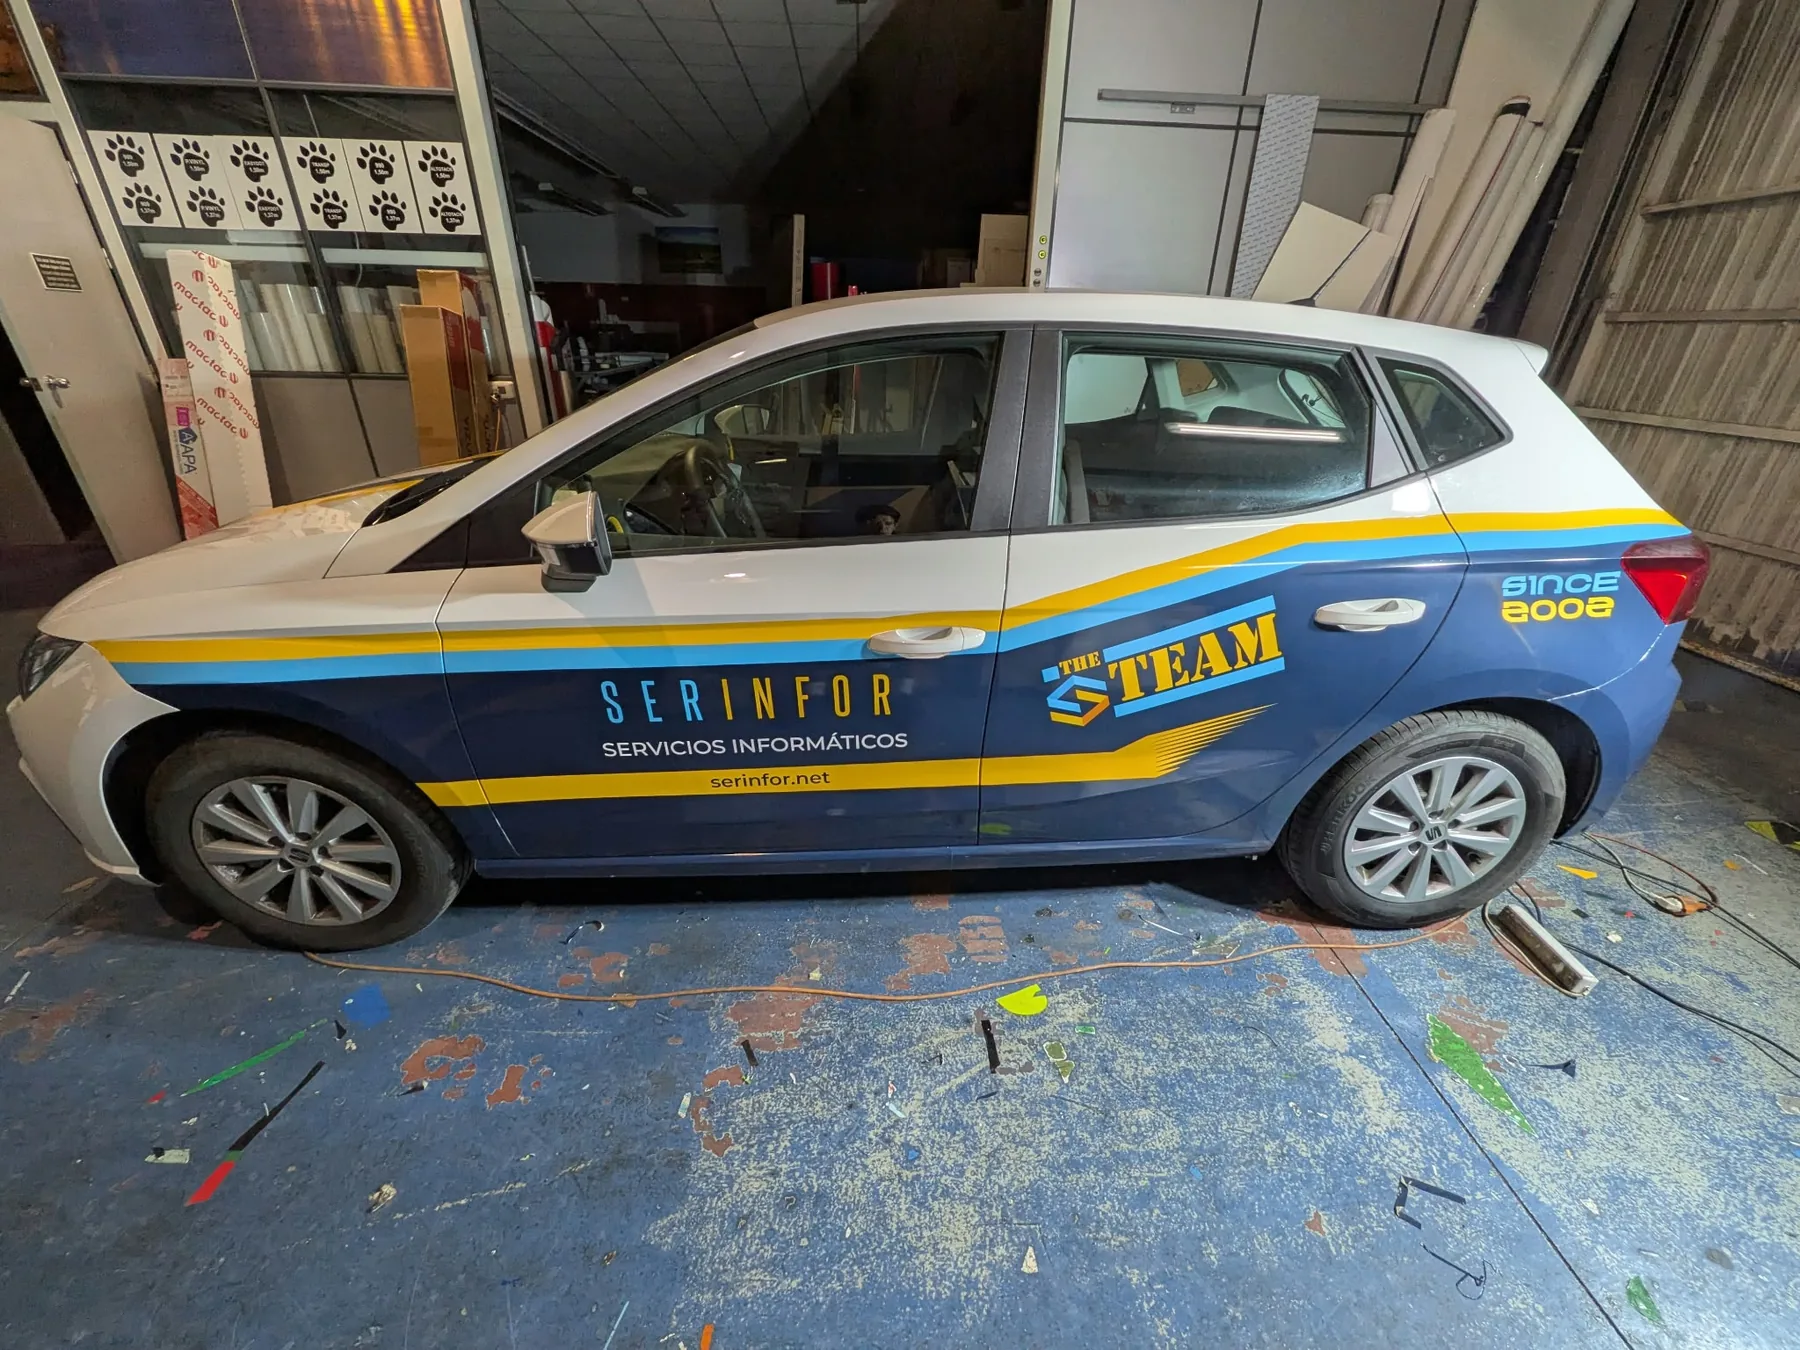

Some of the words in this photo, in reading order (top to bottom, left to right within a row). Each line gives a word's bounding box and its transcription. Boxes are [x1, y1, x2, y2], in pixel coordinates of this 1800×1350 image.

[174, 281, 217, 321] mactac
[207, 275, 241, 320] mactac
[185, 340, 228, 378] mactac
[219, 335, 251, 376] mactac
[196, 397, 238, 435] mactac
[229, 391, 260, 430] mactac
[1501, 570, 1621, 597] SINCE
[1501, 596, 1615, 623] 2002
[1058, 650, 1100, 676] THE
[1107, 612, 1283, 702] TEAM
[600, 673, 892, 724] SERINFOR
[602, 738, 726, 757] SERVICIOS
[732, 731, 908, 754] INFORMÁTICOS
[710, 771, 830, 789] serinfor.net
